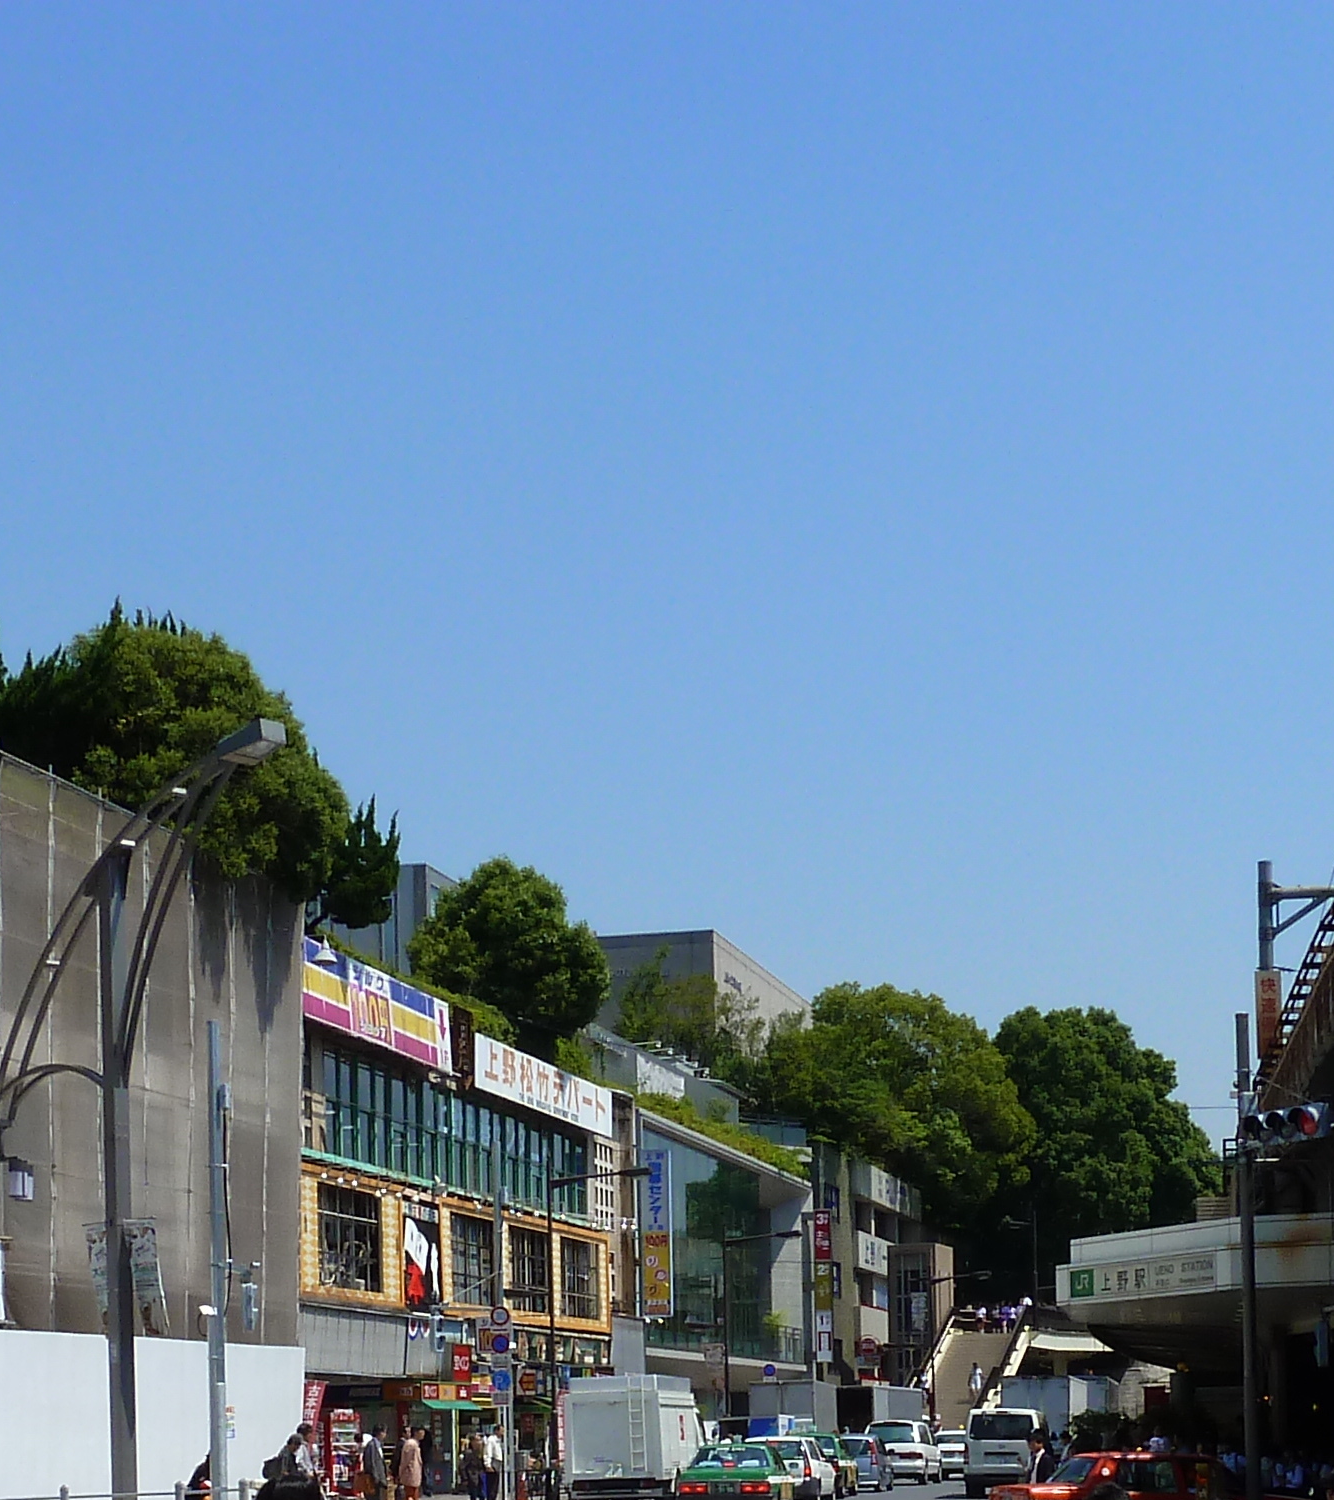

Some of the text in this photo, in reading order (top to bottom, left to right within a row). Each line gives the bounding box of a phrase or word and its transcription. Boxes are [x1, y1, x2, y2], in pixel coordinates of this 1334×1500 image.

[483, 1040, 607, 1124] 上野松竹デパート
[1075, 1273, 1089, 1290] JR
[1100, 1267, 1146, 1292] 上野駅
